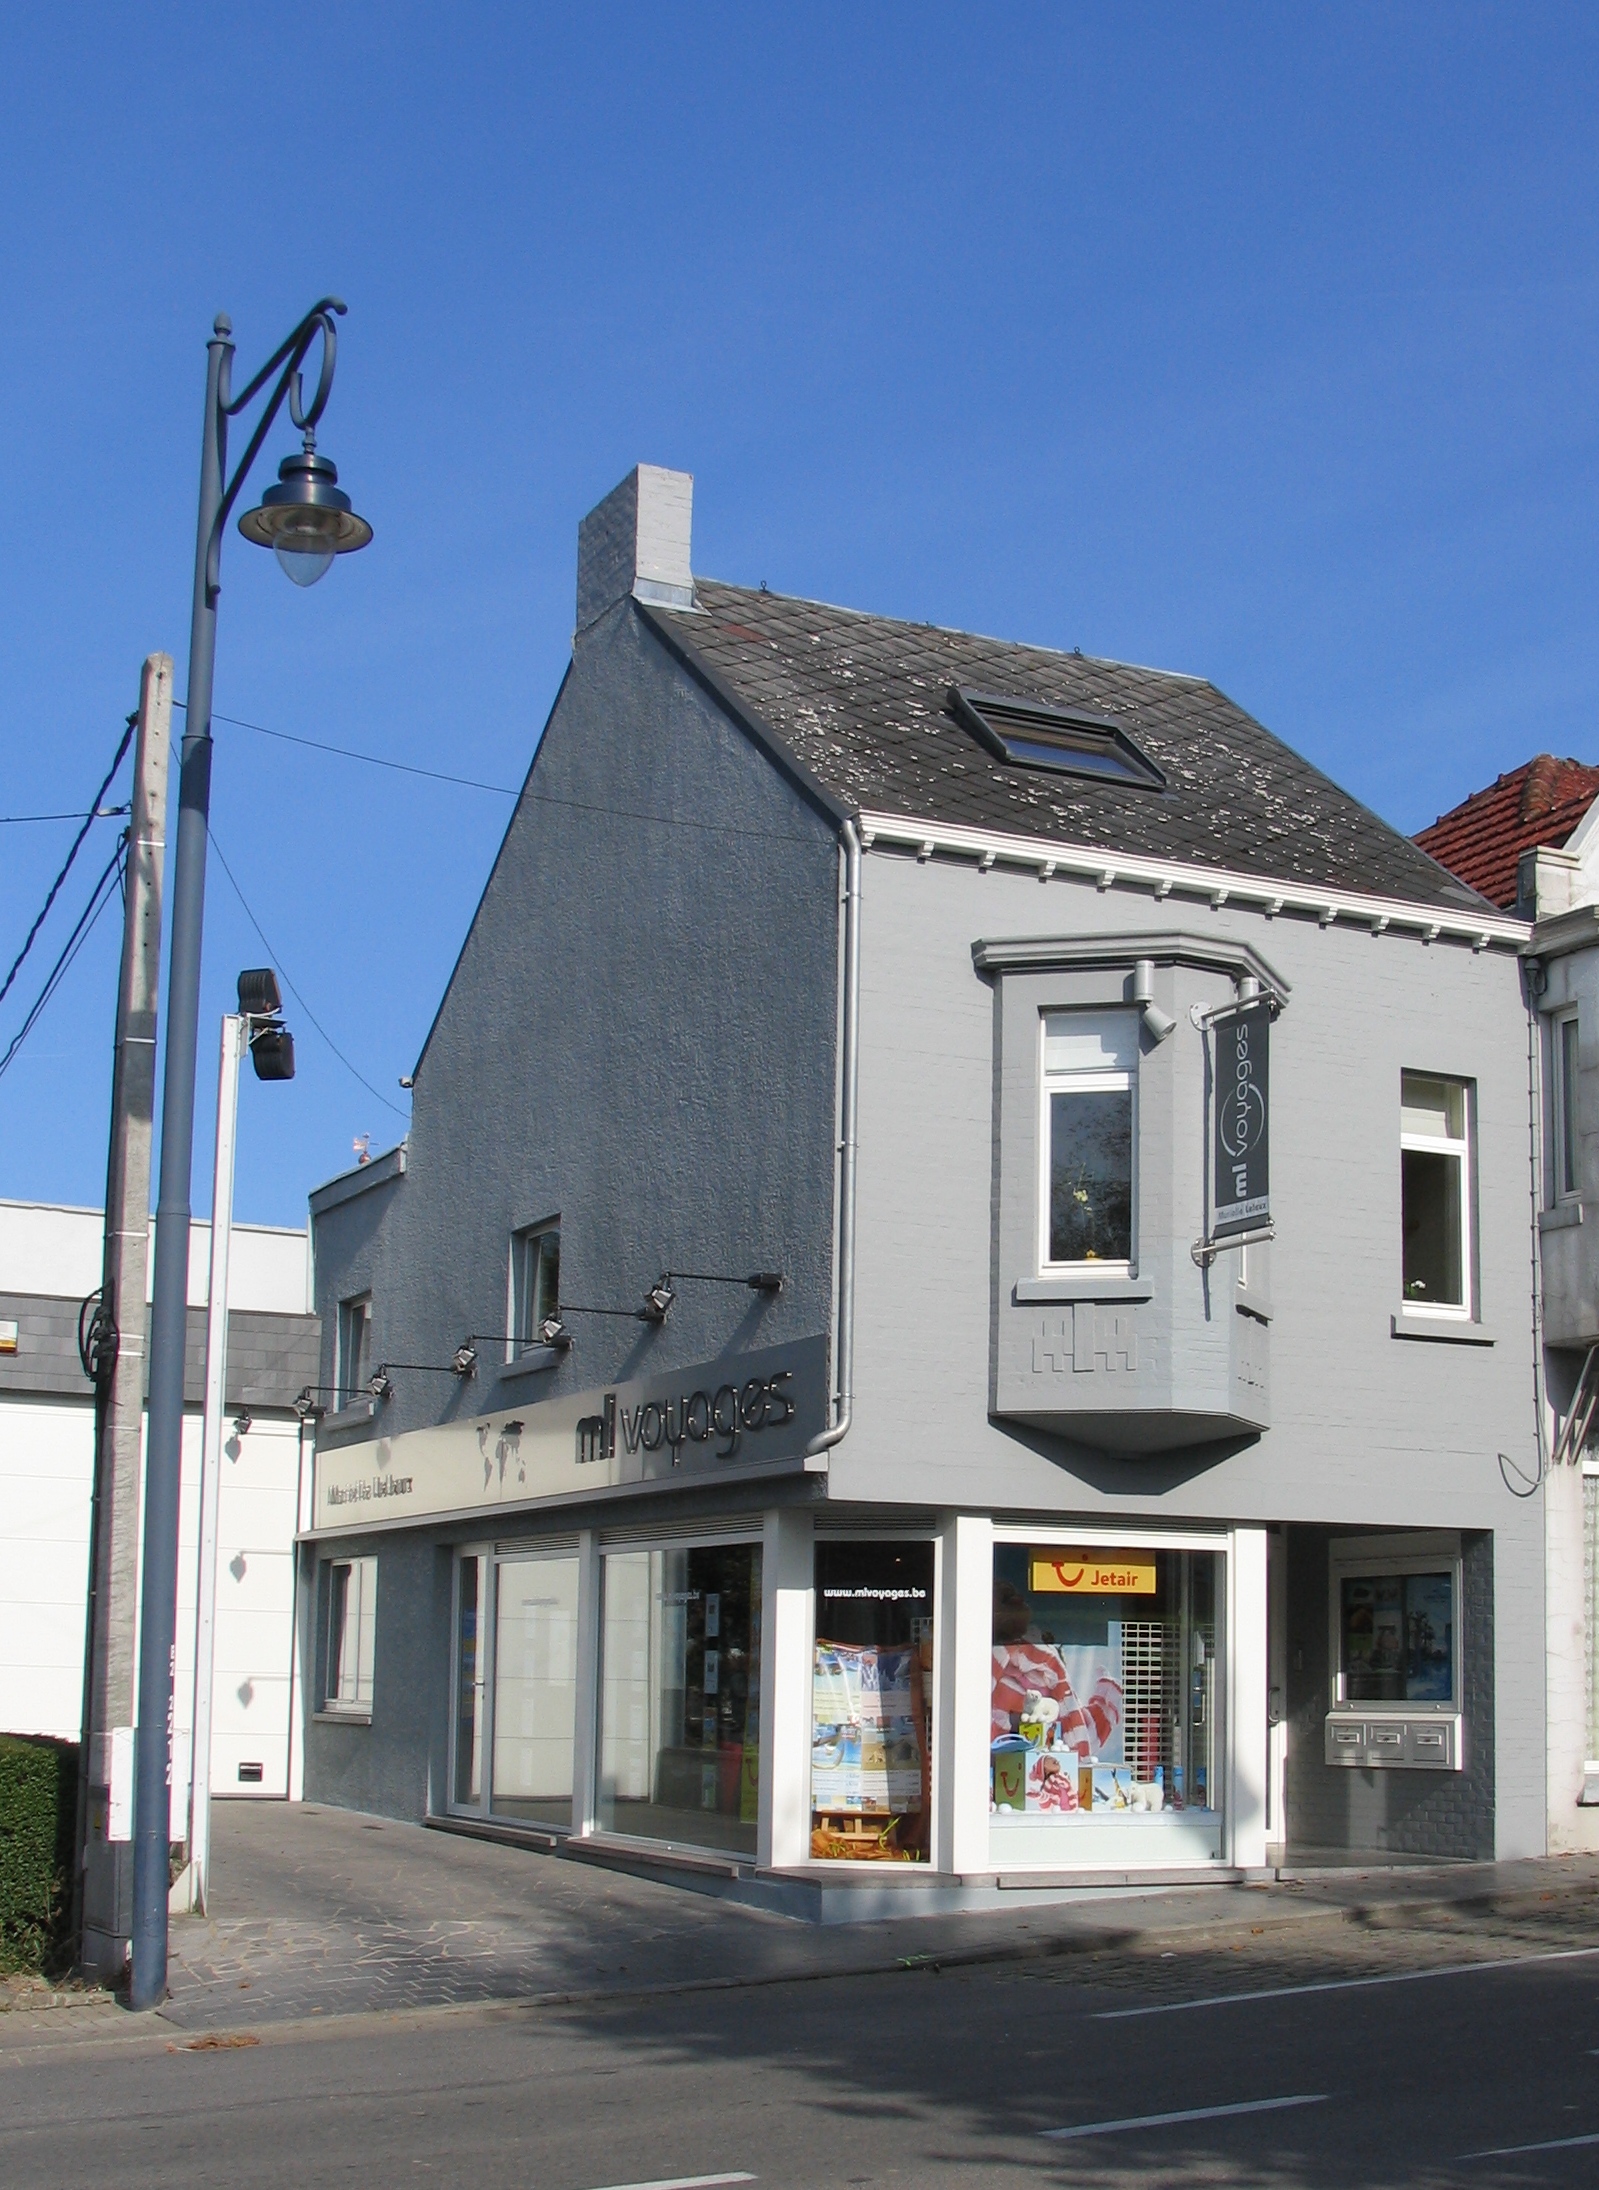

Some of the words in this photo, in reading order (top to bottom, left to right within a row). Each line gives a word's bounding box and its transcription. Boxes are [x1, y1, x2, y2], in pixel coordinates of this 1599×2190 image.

[1235, 1023, 1253, 1158] voyages
[620, 1371, 794, 1467] voyages
[1091, 1570, 1138, 1586] Jetair
